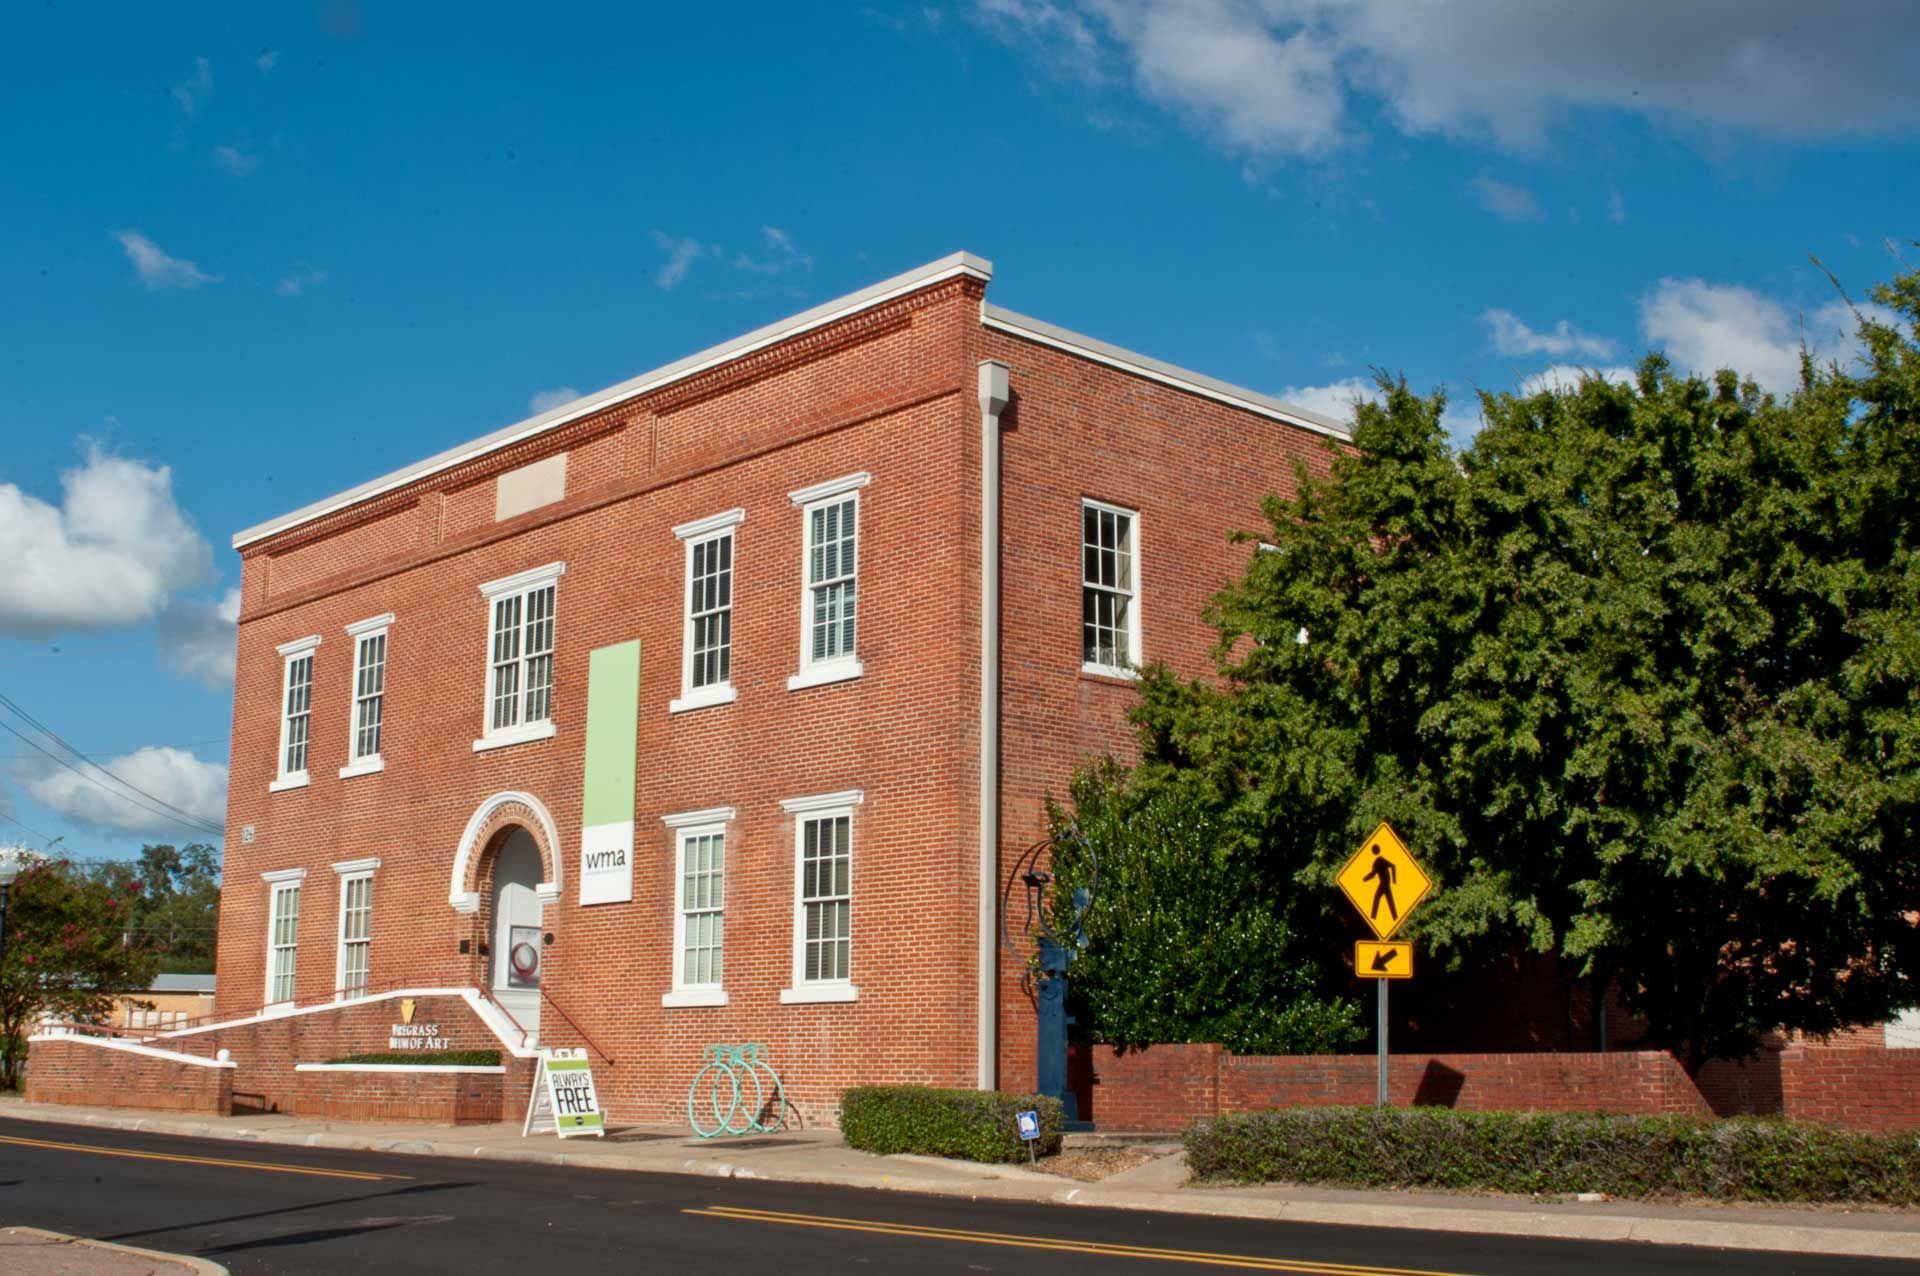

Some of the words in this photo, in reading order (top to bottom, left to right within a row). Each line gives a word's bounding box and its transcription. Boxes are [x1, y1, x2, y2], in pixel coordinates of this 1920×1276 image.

[586, 849, 625, 869] wma
[409, 1038, 424, 1049] OF
[425, 1035, 450, 1049] ART
[552, 1072, 590, 1088] ALWAYS
[555, 1087, 595, 1114] FREE
